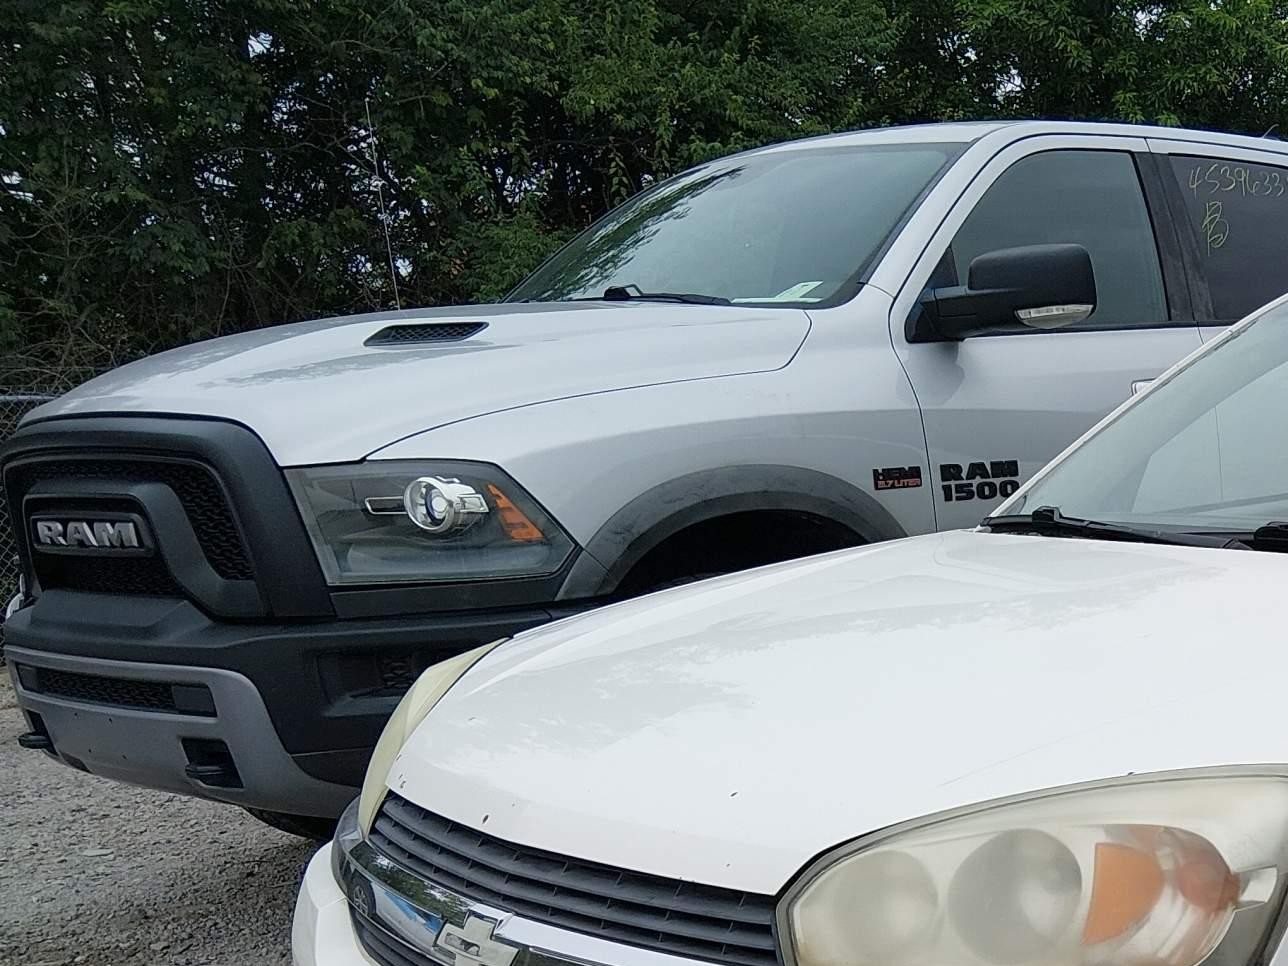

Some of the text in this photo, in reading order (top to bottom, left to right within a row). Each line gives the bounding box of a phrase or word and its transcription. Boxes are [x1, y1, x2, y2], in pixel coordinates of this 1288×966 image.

[940, 460, 1019, 482] RAM
[942, 480, 1020, 502] 1500
[37, 521, 139, 547] RAM
